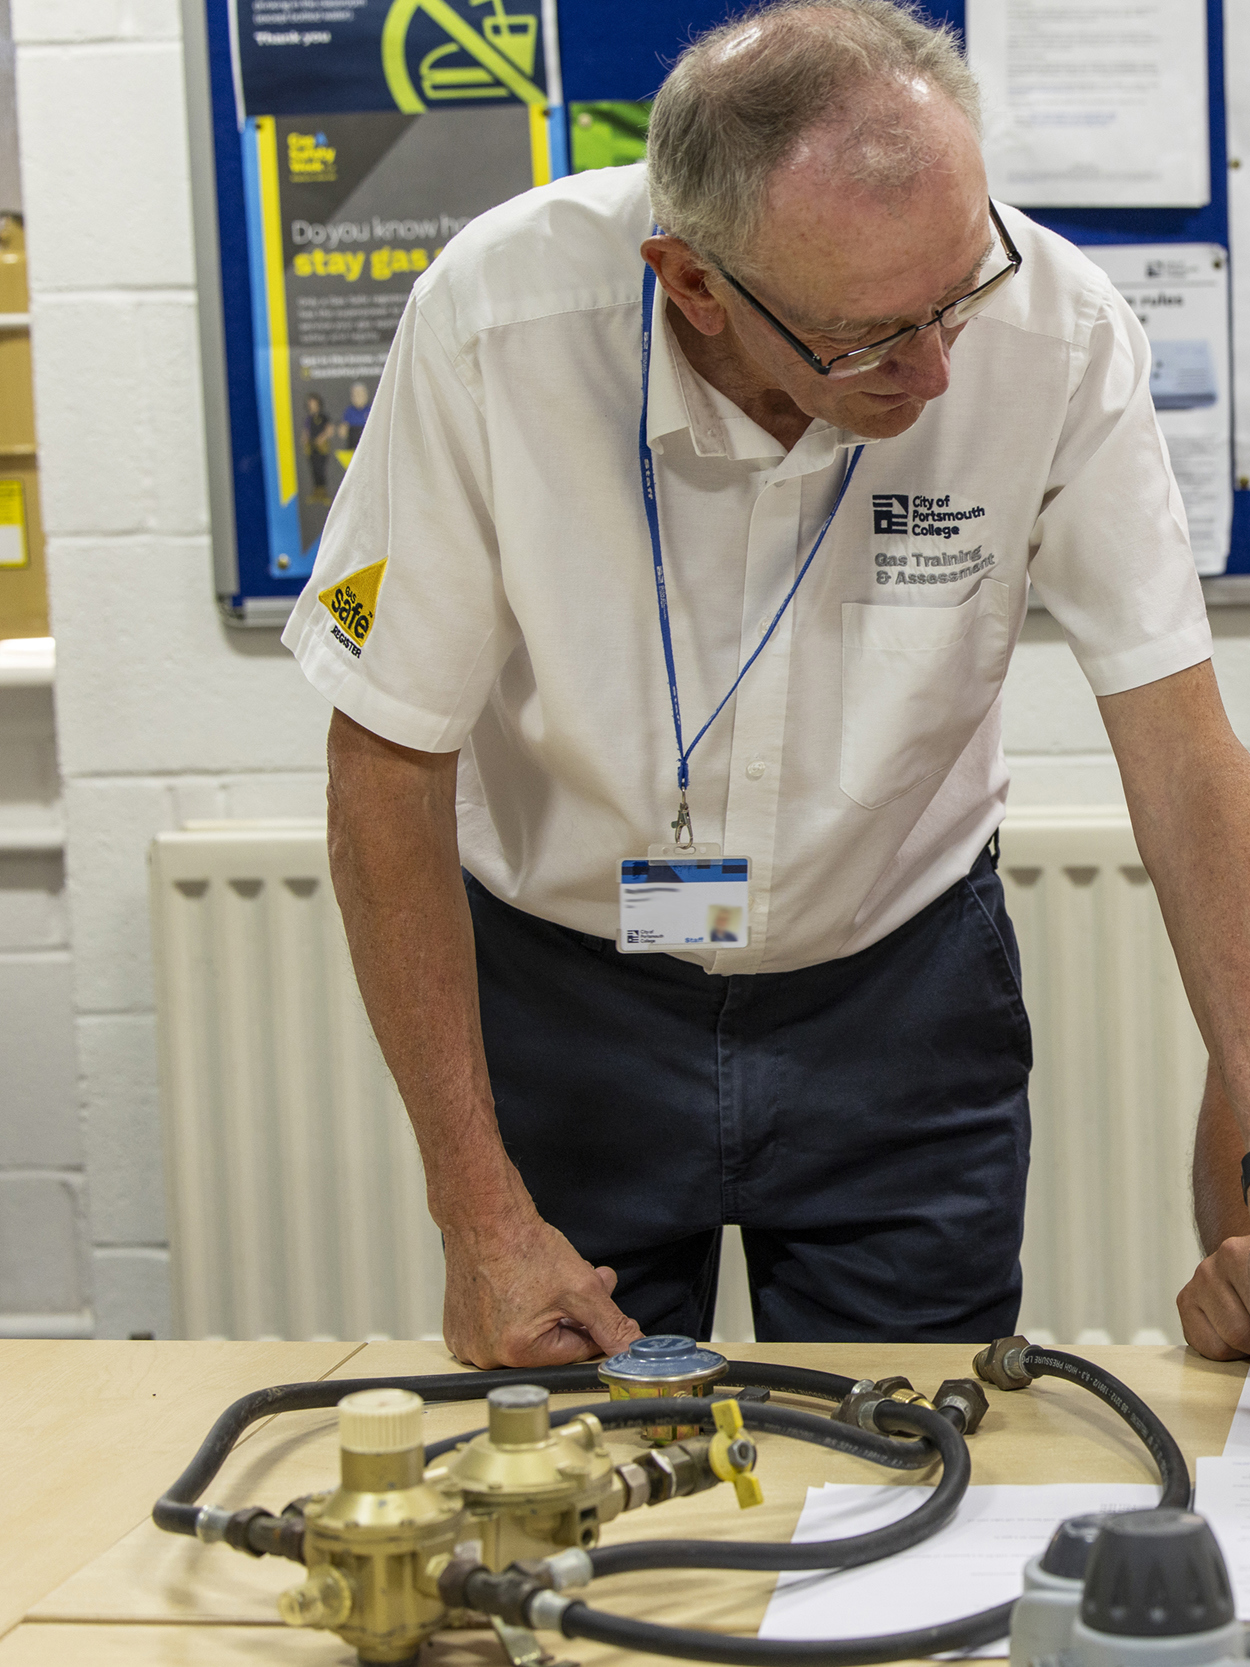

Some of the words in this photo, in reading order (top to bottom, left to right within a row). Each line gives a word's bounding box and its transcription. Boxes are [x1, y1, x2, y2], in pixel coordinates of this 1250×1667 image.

[291, 219, 327, 245] Do
[326, 221, 371, 249] you
[371, 214, 438, 241] know
[293, 247, 365, 282] stay
[370, 245, 429, 281] gas
[913, 496, 934, 510] City
[936, 495, 950, 508] of
[912, 506, 985, 522] Portsmouth
[912, 524, 960, 539] College
[875, 552, 908, 567] Gas
[912, 545, 982, 567] Training
[876, 570, 891, 584] &
[895, 552, 995, 585] Assessment
[345, 586, 357, 604] GAS
[330, 625, 361, 659] REGISTER
[1035, 1356, 1064, 1369] PRESSURE
[1064, 1363, 1079, 1375] HIGH
